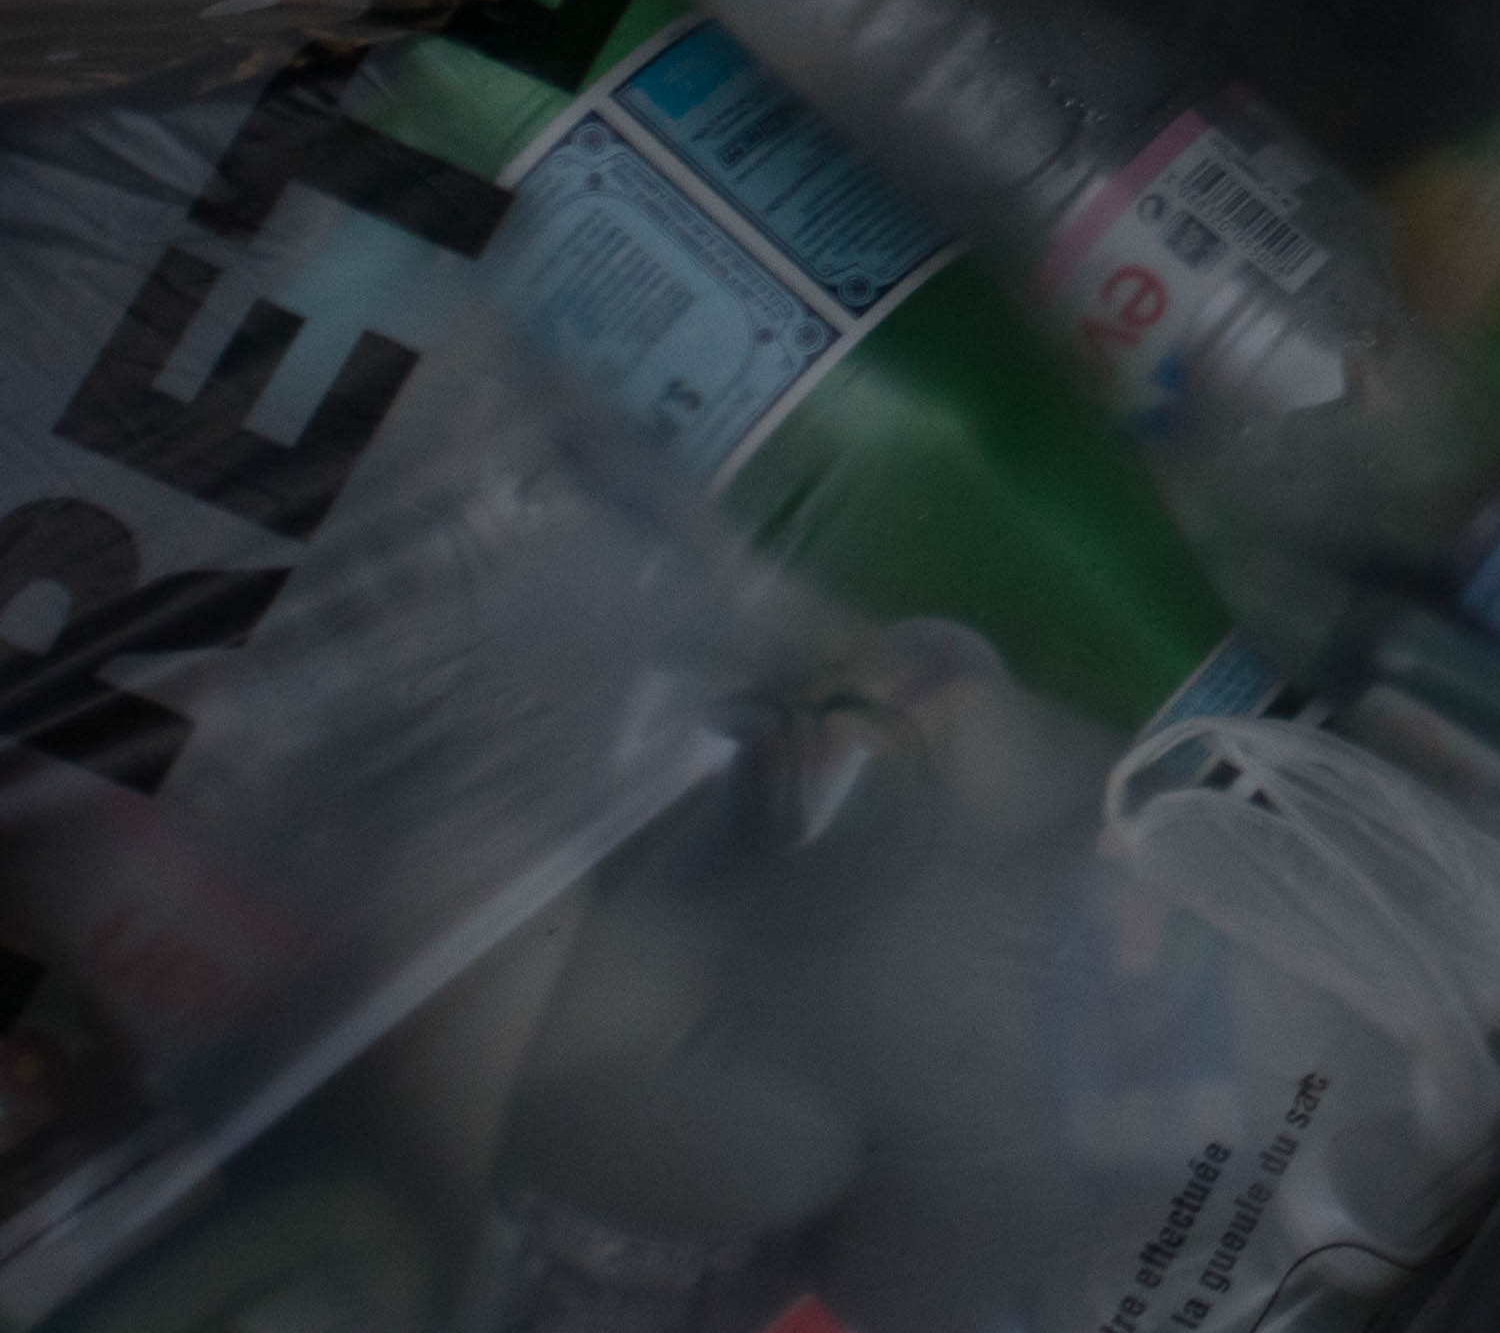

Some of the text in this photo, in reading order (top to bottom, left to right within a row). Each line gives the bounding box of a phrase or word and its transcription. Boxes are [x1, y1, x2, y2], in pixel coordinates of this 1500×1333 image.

[1135, 1138, 1232, 1290] effectuée
[1171, 1285, 1210, 1333] la
[1195, 1176, 1275, 1294] gueule
[1267, 1125, 1301, 1185] du
